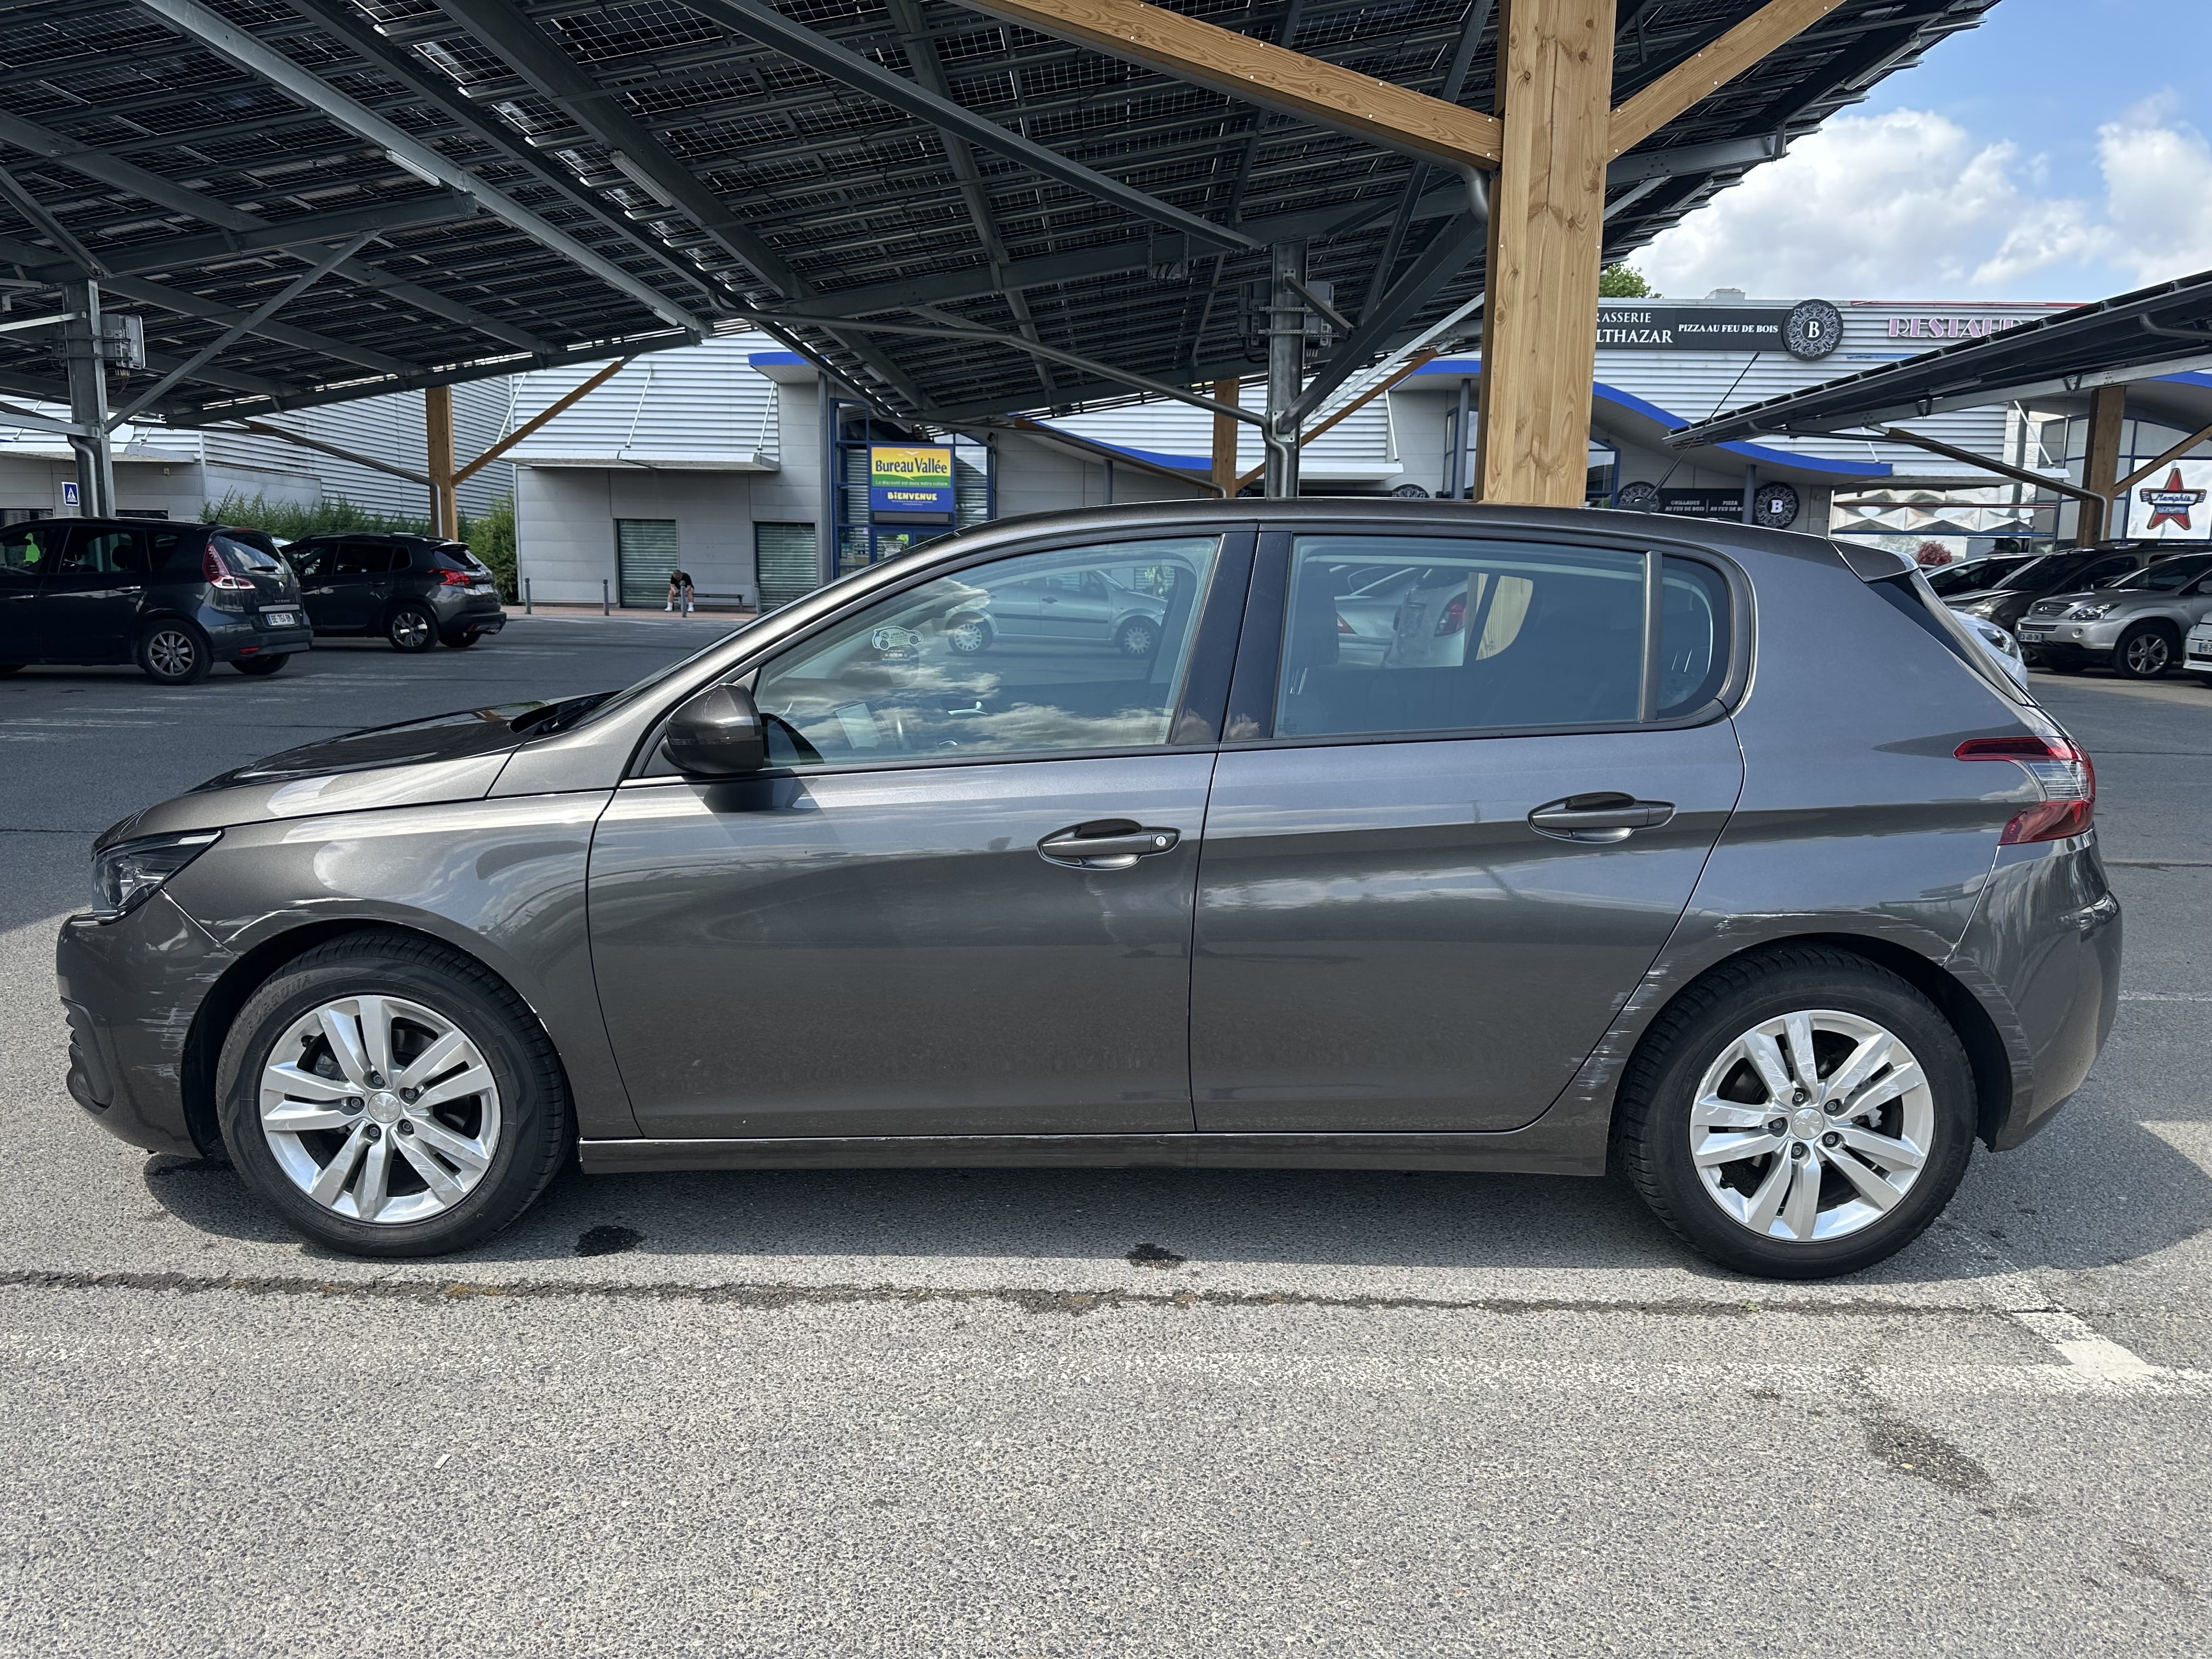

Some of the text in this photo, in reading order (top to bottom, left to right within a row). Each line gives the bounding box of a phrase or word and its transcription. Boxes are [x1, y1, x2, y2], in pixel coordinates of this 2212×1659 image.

[1678, 324, 1705, 332] PIZZA
[1722, 325, 1740, 333] FEU
[1742, 325, 1755, 333] DE
[1756, 325, 1779, 334] BOIS
[1808, 321, 1820, 338] B
[876, 457, 947, 474] Bureau Vallée
[2154, 492, 2193, 503] Memphis
[1771, 499, 1784, 514] B
[246, 974, 313, 1036] FORTUNA
